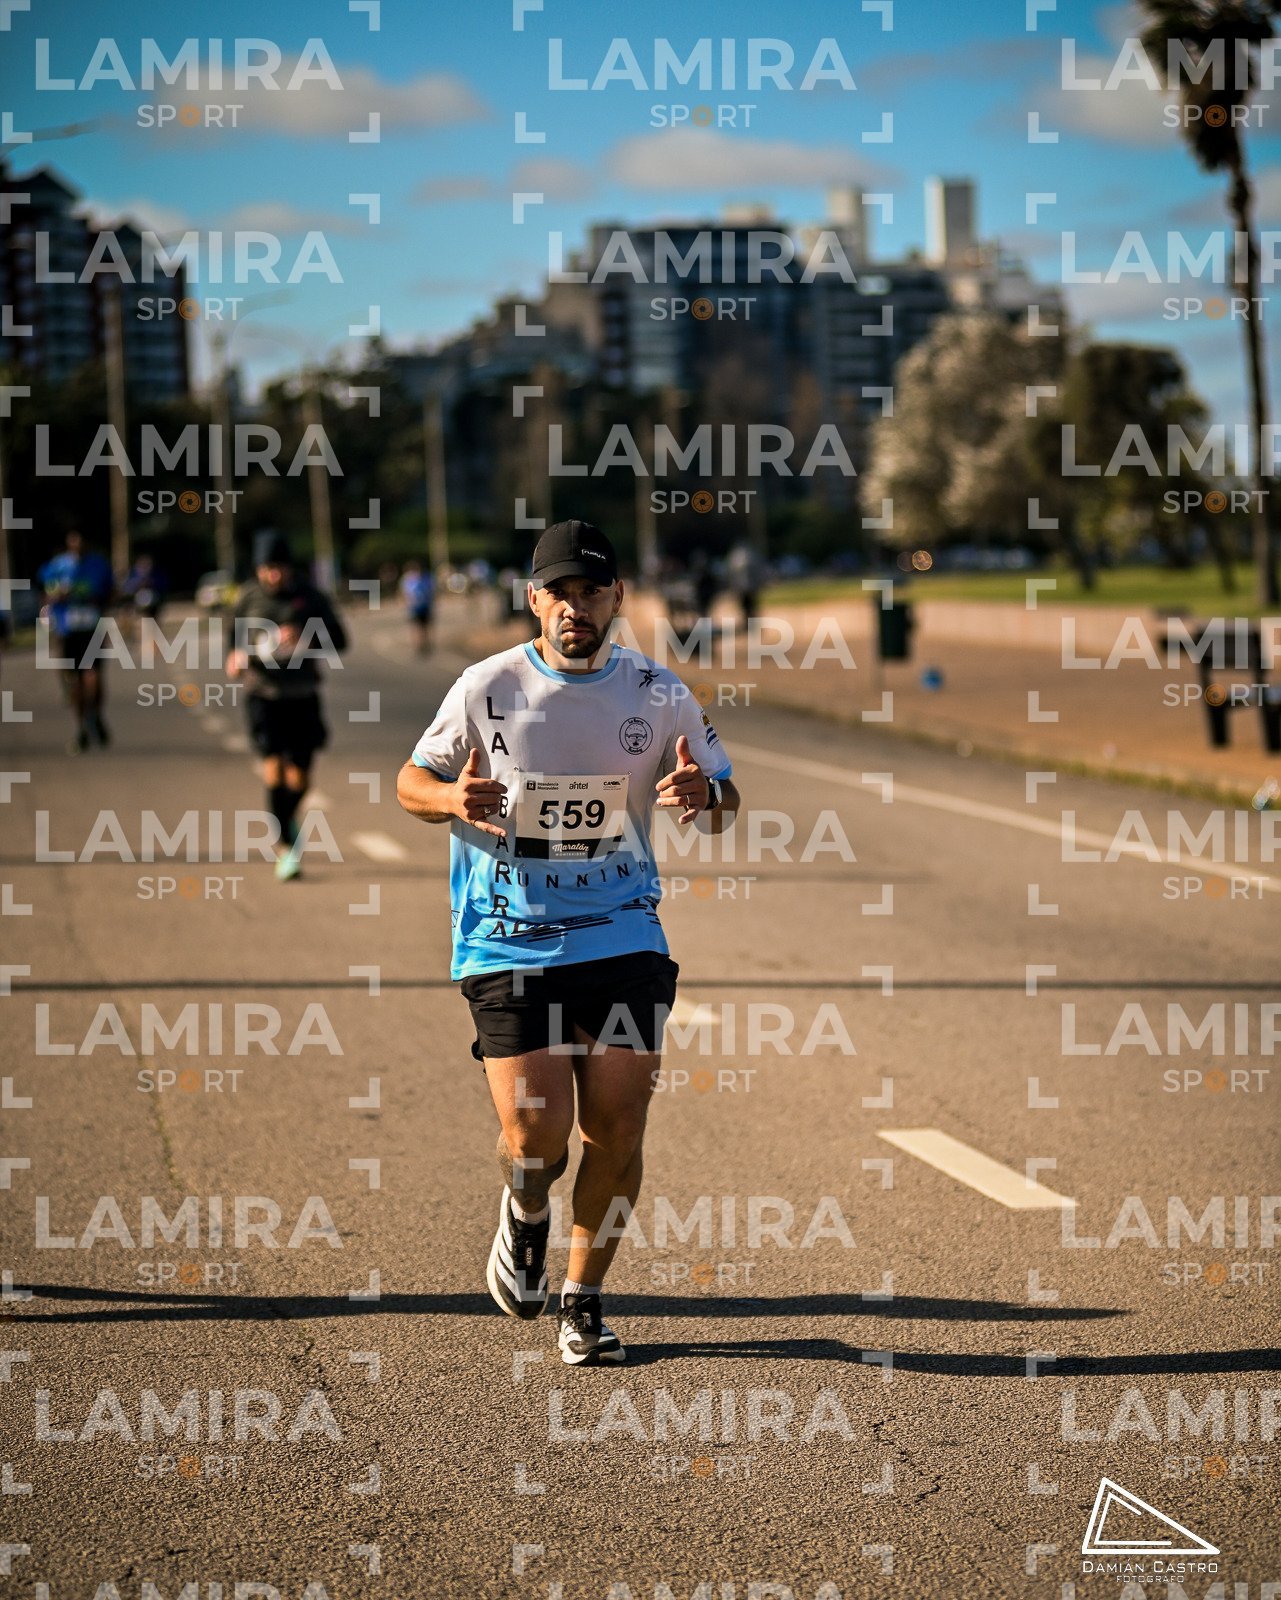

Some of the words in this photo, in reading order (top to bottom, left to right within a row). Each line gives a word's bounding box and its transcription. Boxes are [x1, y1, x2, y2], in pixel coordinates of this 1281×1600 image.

[569, 782, 589, 790] antel
[538, 800, 606, 830] 559
[552, 843, 590, 853] Maratón
